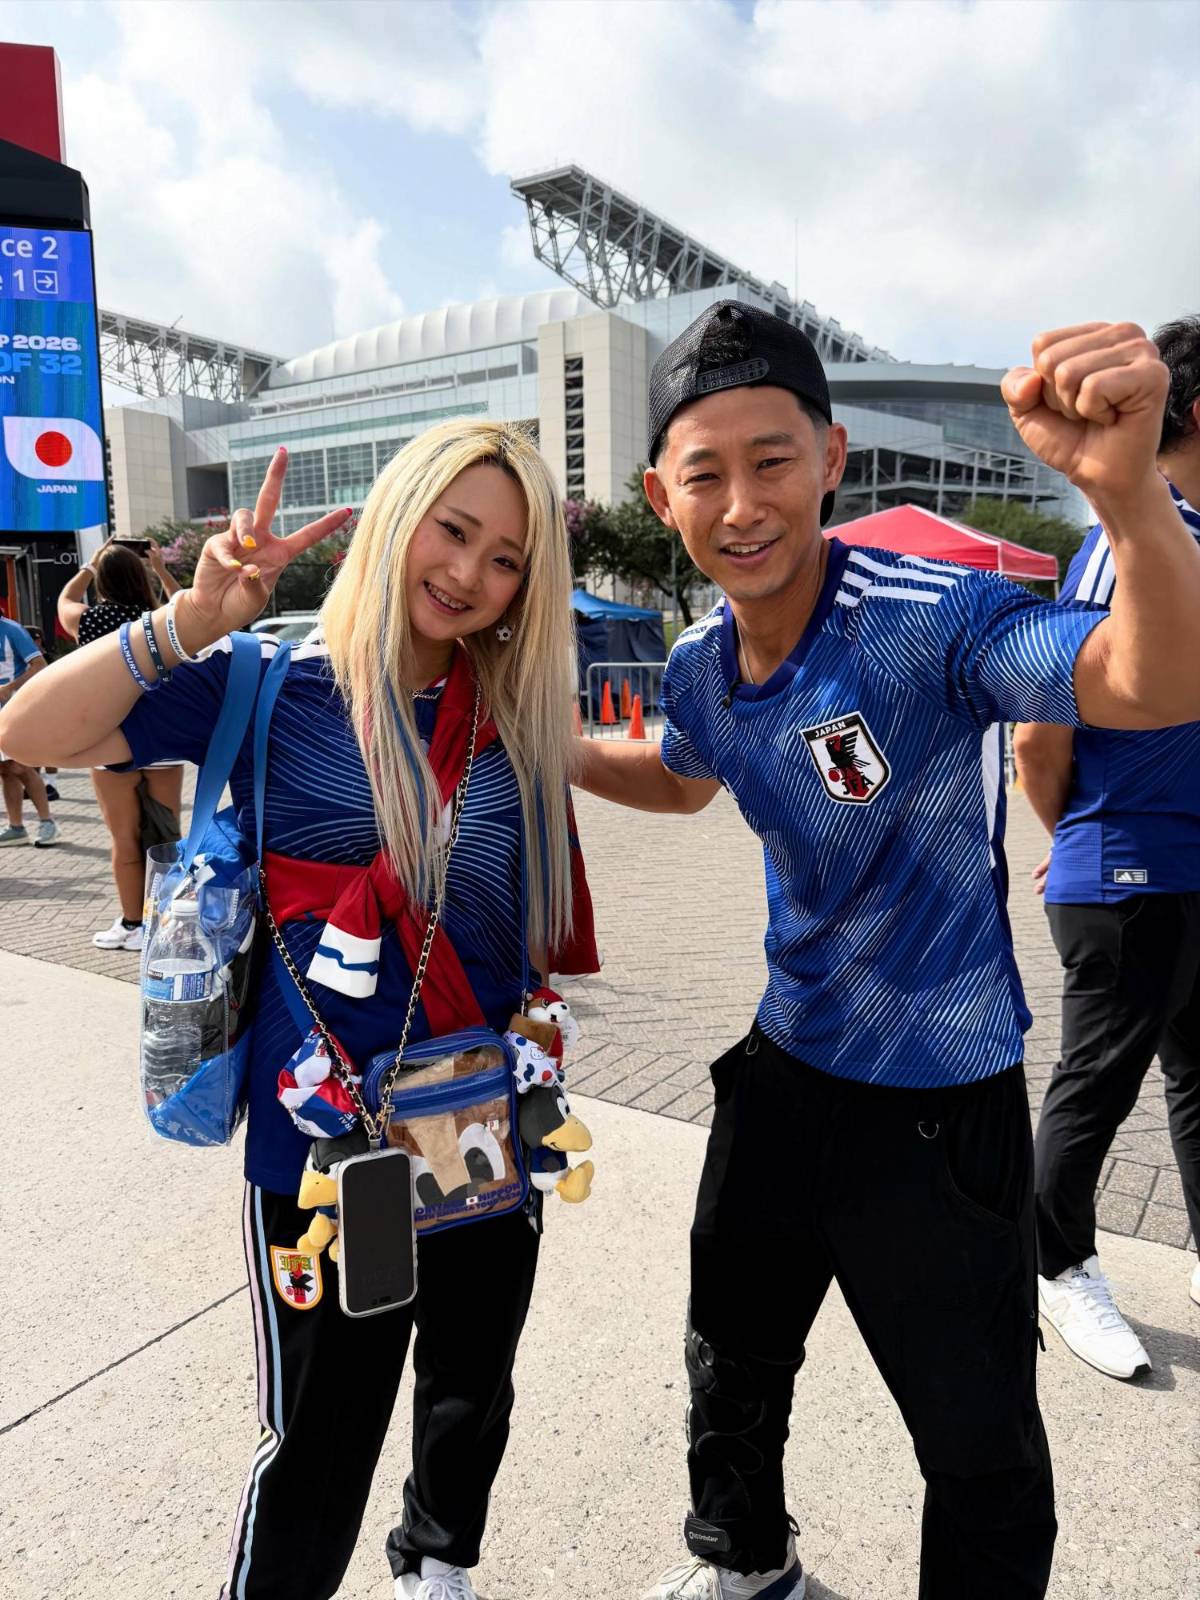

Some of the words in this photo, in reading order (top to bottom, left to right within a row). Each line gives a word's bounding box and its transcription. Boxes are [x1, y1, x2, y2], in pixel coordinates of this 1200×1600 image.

[1, 238, 33, 258] ce
[41, 236, 59, 260] 2
[13, 269, 25, 292] 1
[12, 334, 78, 351] 2026
[39, 353, 82, 376] 32
[37, 484, 78, 494] JAPAN
[145, 630, 158, 653] BLUE
[120, 639, 141, 679] SAMURAI
[815, 721, 846, 738] JAPAN
